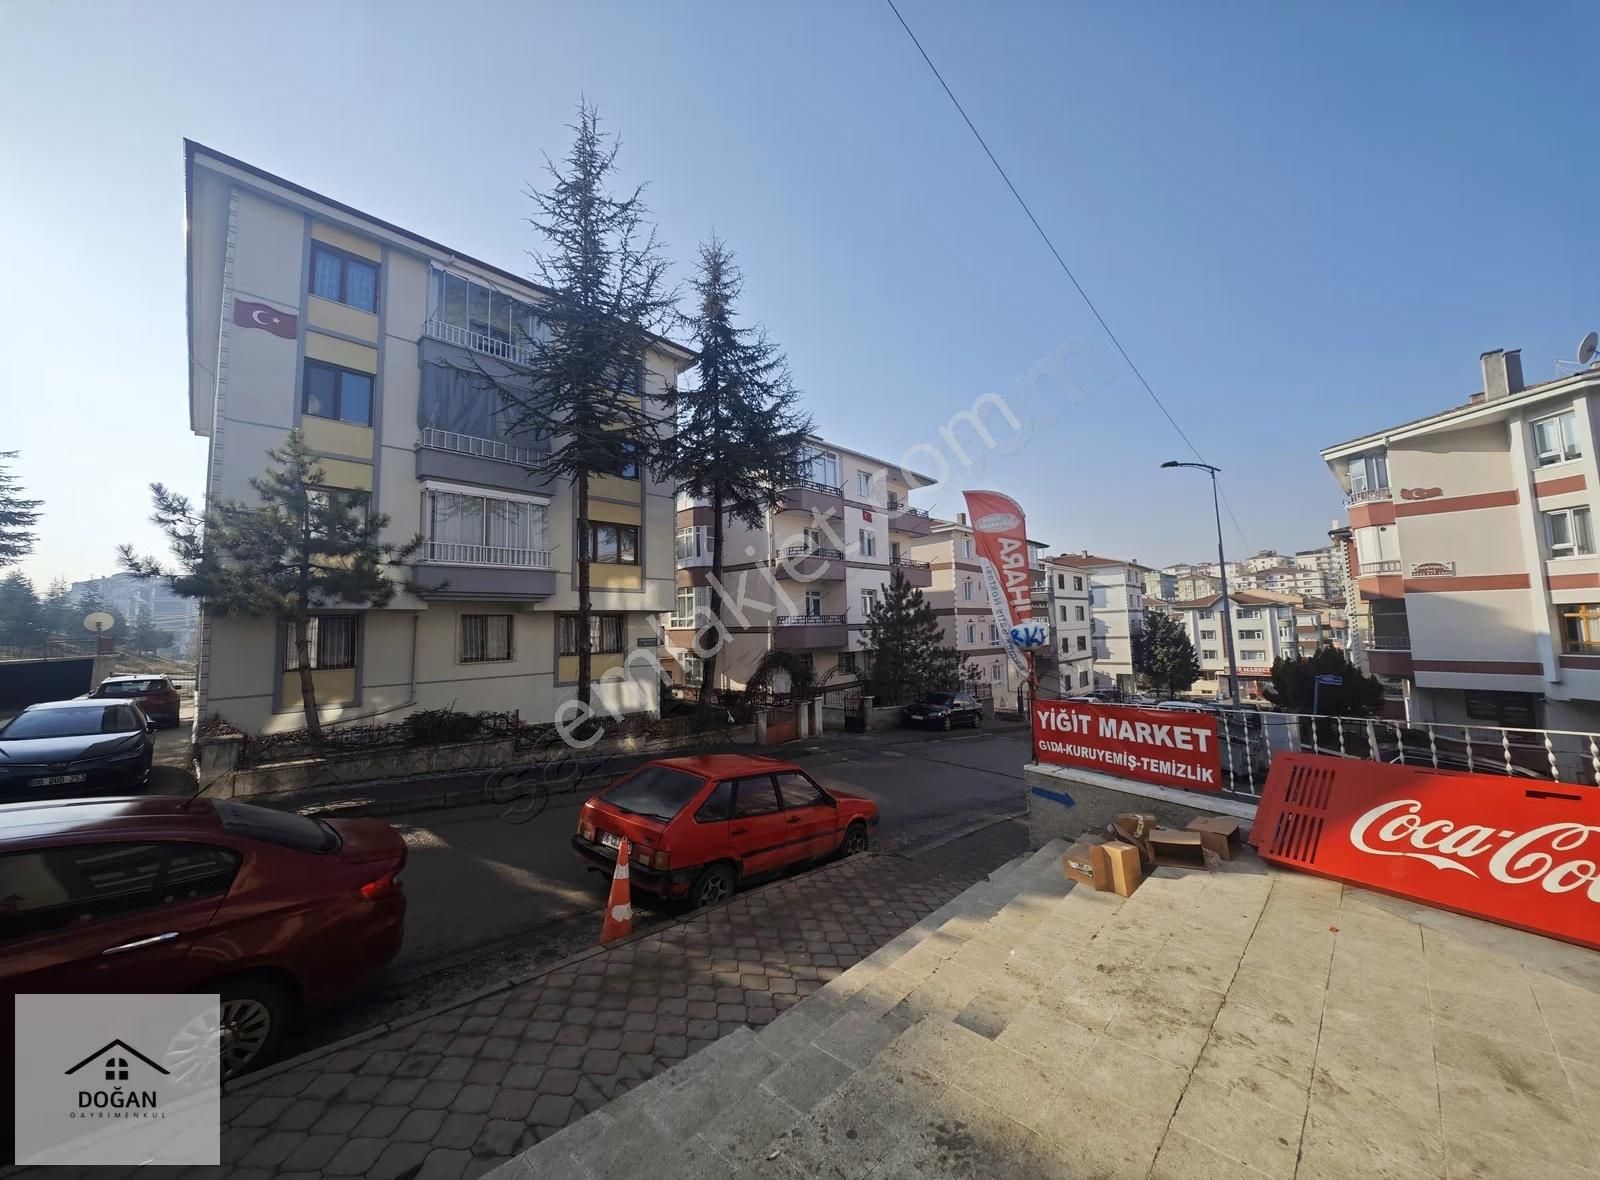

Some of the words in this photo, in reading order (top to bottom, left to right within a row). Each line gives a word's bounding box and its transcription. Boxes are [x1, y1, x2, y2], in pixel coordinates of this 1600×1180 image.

[1036, 707, 1092, 735] YİĞİT
[1098, 716, 1212, 753] MARKET
[1038, 739, 1215, 784] GIDA-KURUYEMİŞ-TEMİZLİK
